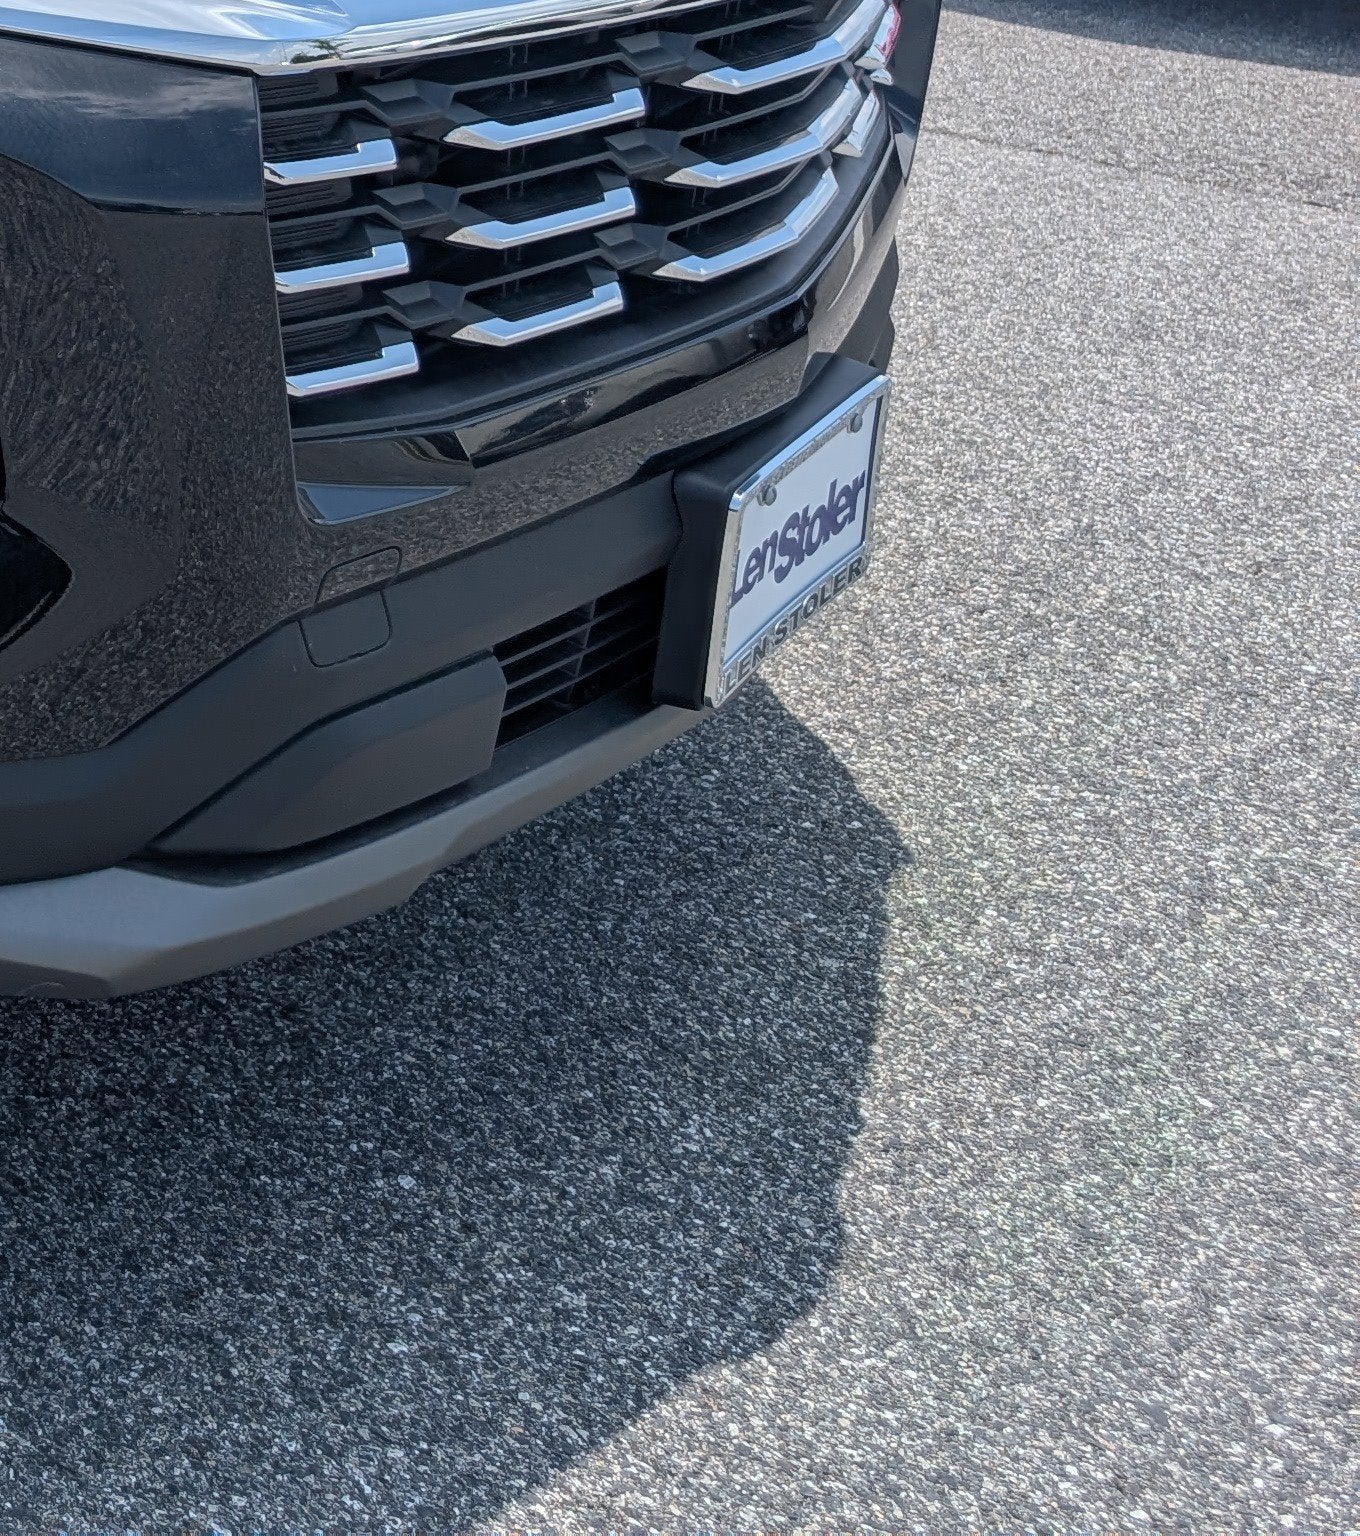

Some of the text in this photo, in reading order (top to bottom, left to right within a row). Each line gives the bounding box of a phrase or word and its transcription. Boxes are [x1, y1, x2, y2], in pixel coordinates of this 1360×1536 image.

[730, 470, 865, 607] LenStoler
[724, 556, 863, 694] LEN STOLER
